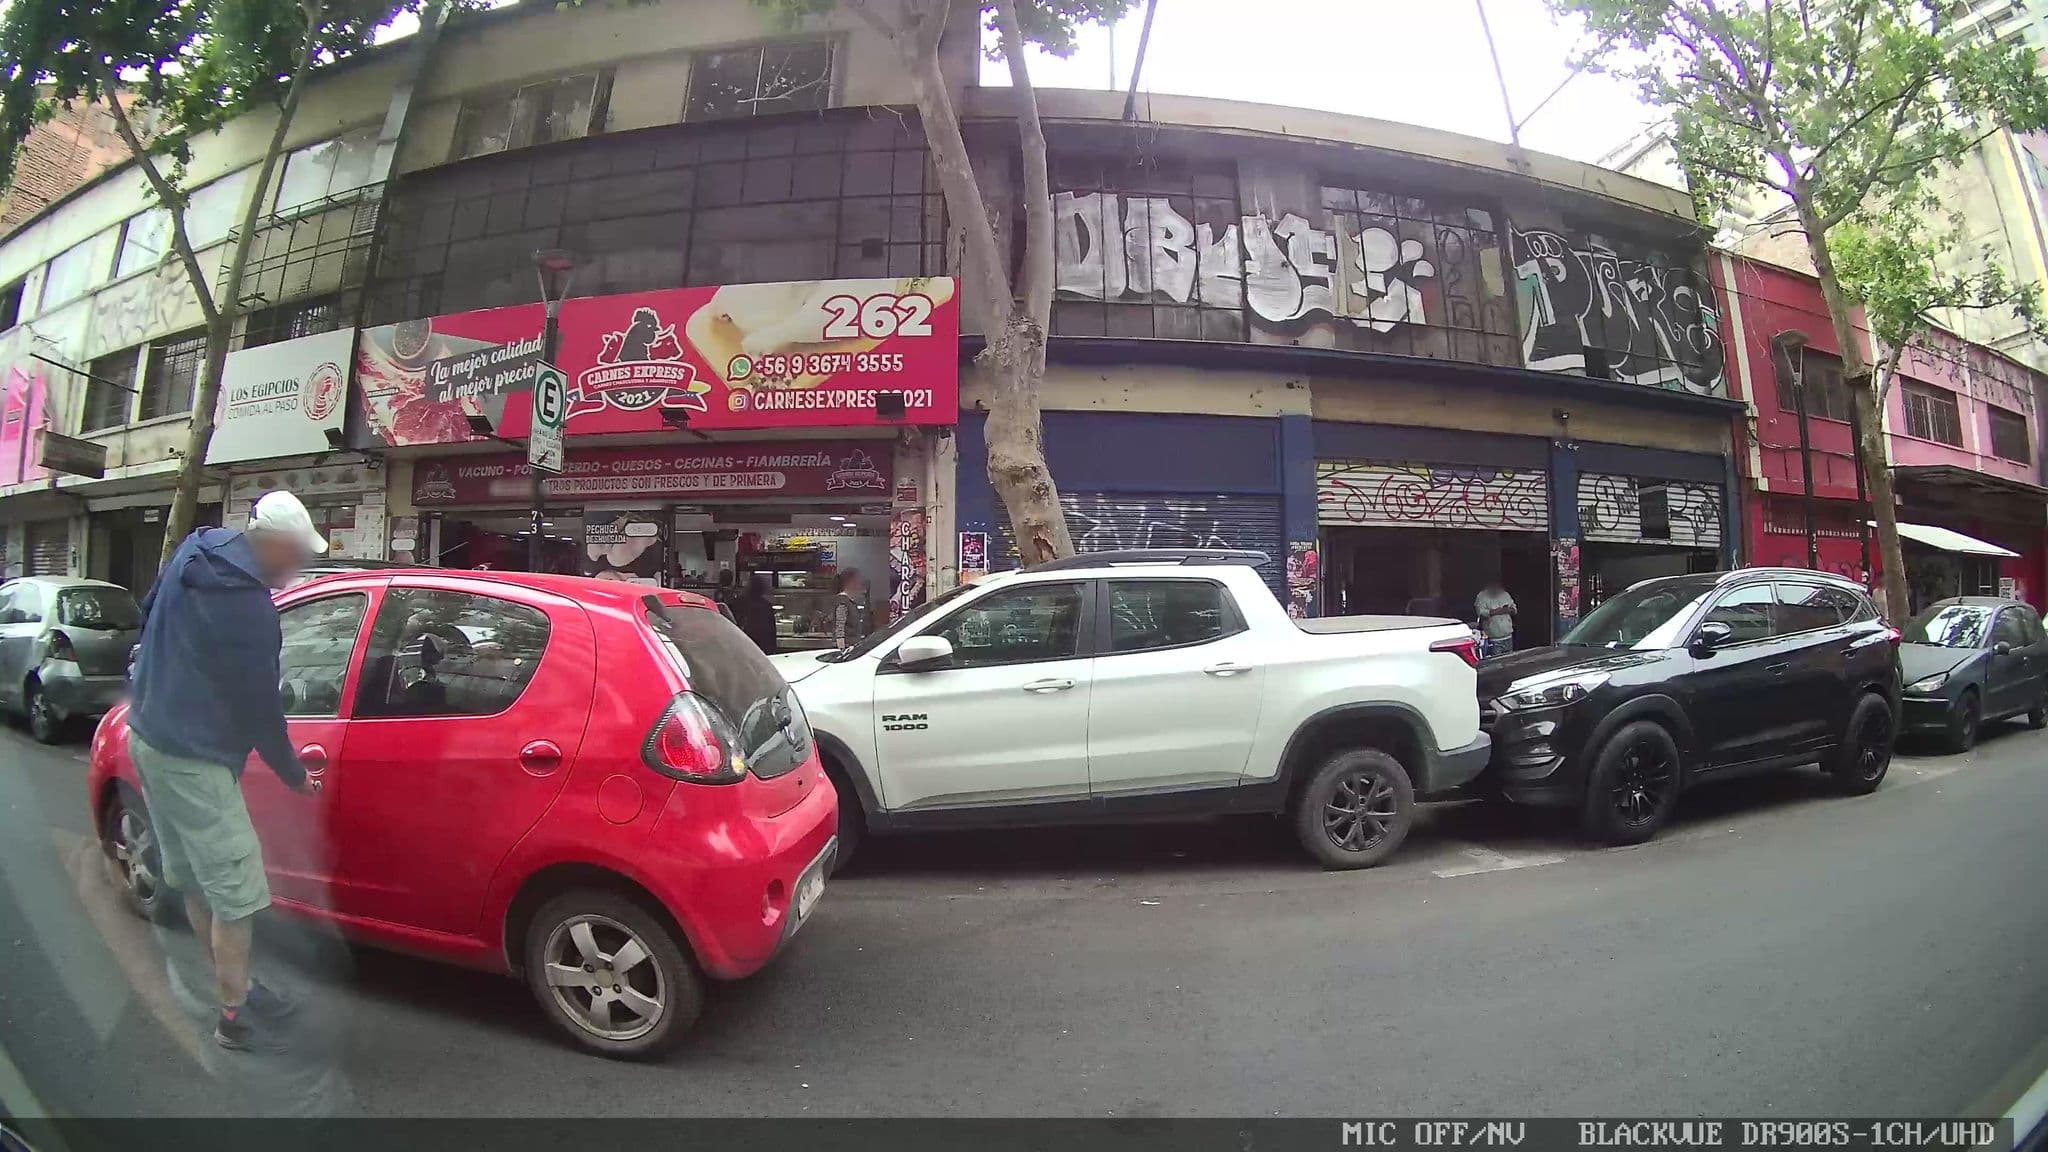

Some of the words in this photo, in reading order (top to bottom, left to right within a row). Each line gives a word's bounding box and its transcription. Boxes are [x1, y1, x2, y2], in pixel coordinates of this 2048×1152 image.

[822, 293, 935, 340] 262
[431, 361, 450, 385] La
[452, 352, 488, 379] mejor
[491, 332, 544, 363] calidad
[755, 356, 786, 375] +56
[792, 355, 803, 374] 9
[809, 354, 851, 374] 3674
[857, 353, 903, 372] 3555
[439, 383, 454, 403] al
[456, 376, 492, 397] mejor
[494, 362, 535, 395] precio
[587, 367, 631, 386] CARNES
[633, 365, 685, 380] EXPRESS
[230, 387, 249, 402] LOS
[251, 378, 299, 398] EGIPCIOS
[543, 381, 557, 418] E
[618, 390, 652, 404] 2021
[754, 389, 933, 410] CARNESEXPRES021
[275, 398, 298, 411] PASO
[458, 466, 504, 478] VACUNO
[612, 458, 662, 473] QUESOS
[674, 456, 733, 469] CECINAS
[747, 452, 831, 468] FIAMBRERÍA
[574, 478, 627, 491] PRODUCTOS
[632, 477, 651, 489] SON
[654, 475, 700, 488] FRESCOS
[703, 475, 710, 488] Y
[712, 474, 727, 487] DE
[730, 473, 776, 486] PRIMERA
[586, 525, 618, 534] PECHUGA
[882, 713, 928, 722] RAM
[883, 723, 928, 731] 1000
